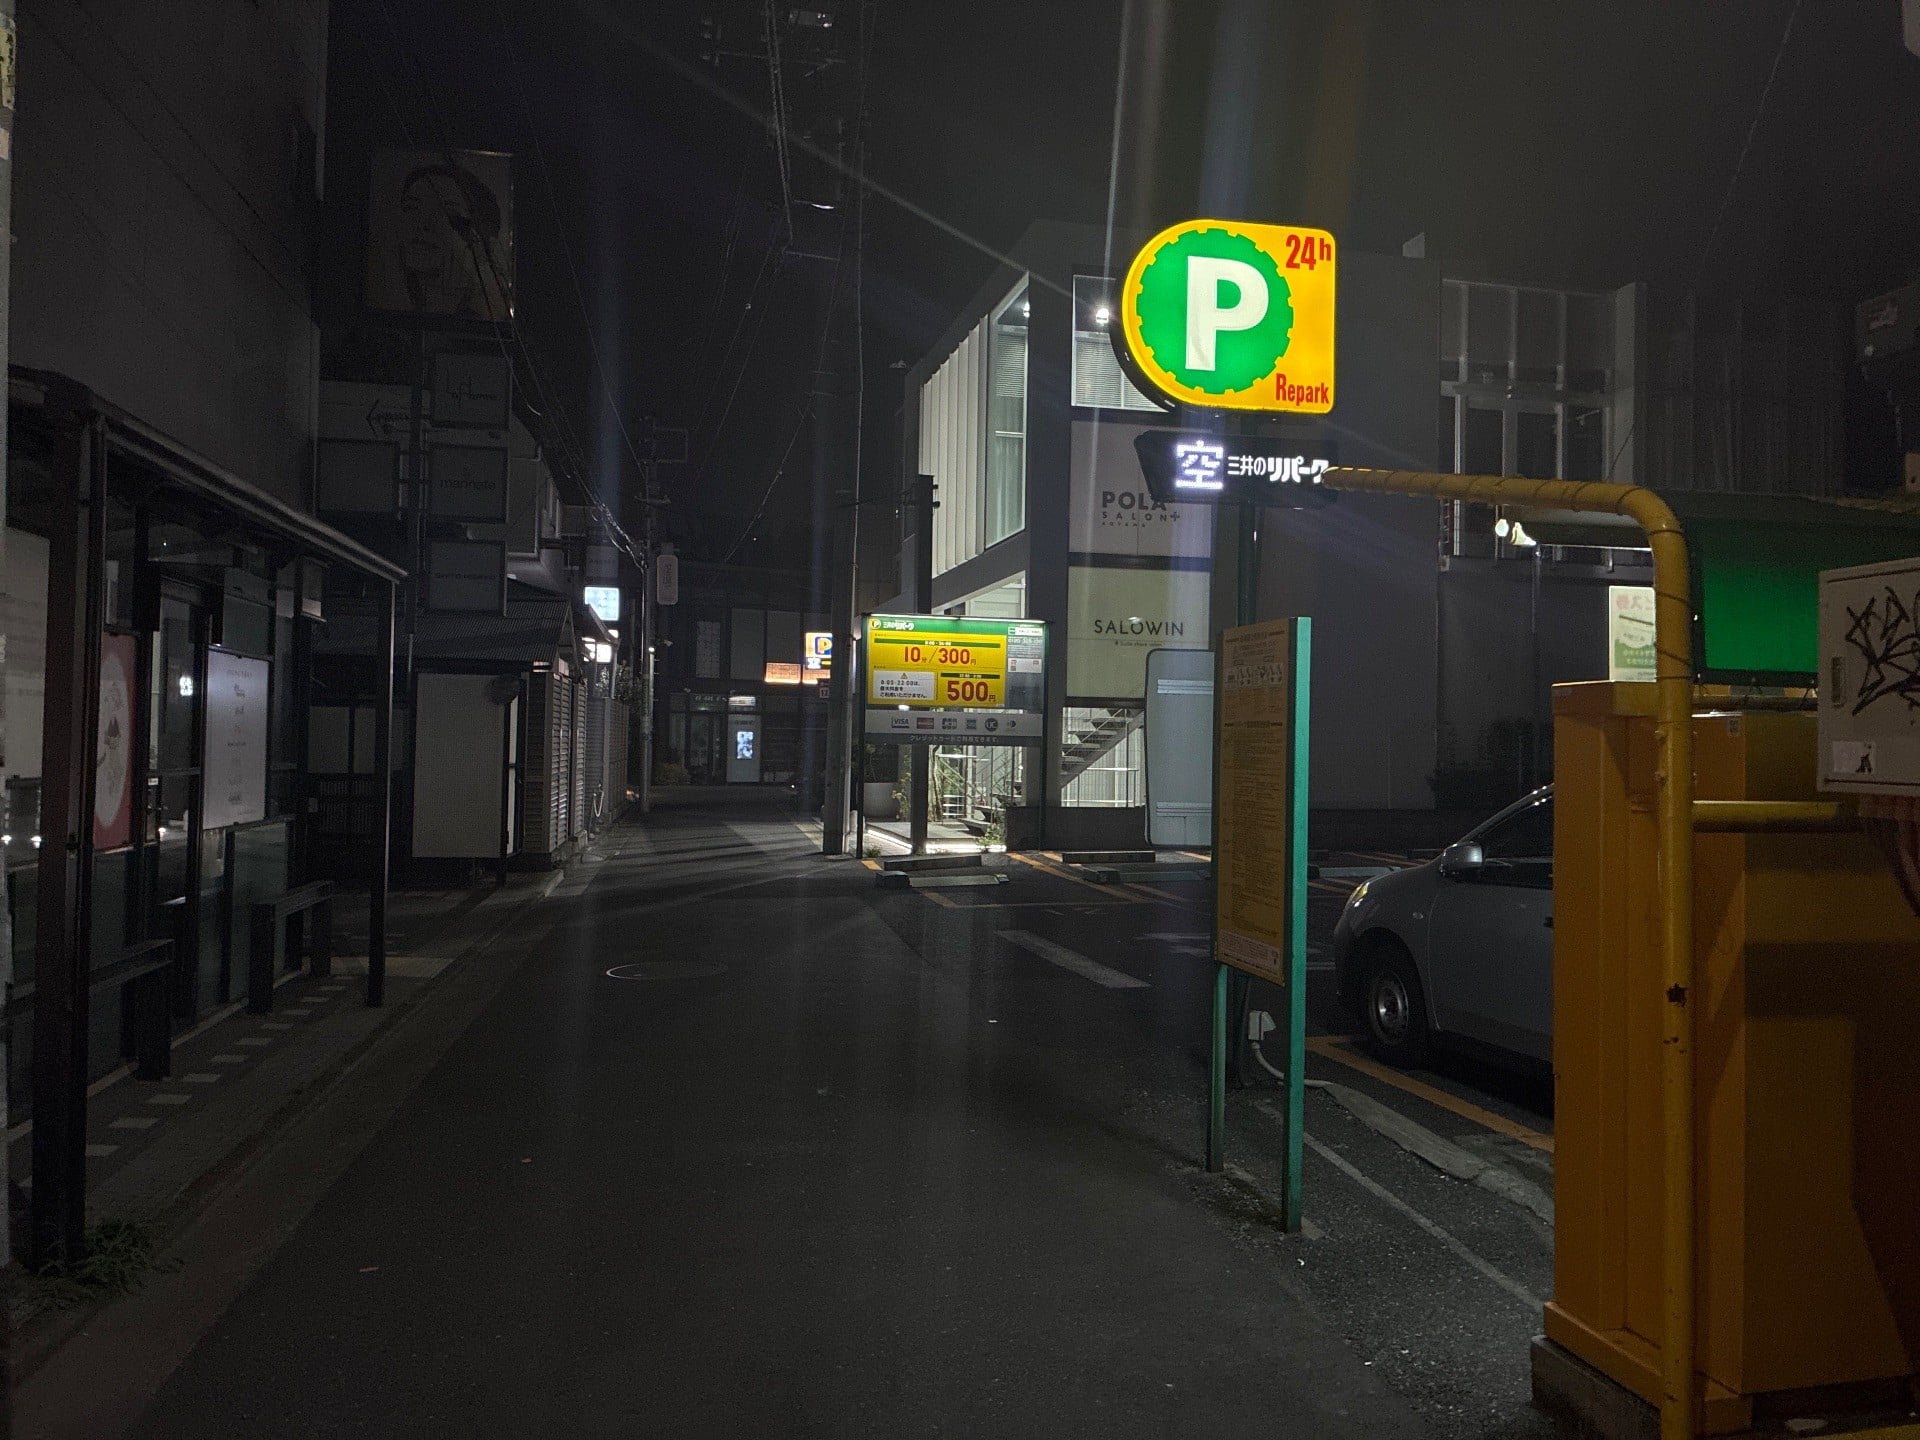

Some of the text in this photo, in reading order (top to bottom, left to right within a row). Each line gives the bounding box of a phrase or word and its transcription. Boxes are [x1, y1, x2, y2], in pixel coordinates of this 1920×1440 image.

[1286, 234, 1332, 270] 24h
[1185, 256, 1269, 371] P
[1276, 373, 1329, 406] Repark
[1176, 440, 1223, 489] 空
[1227, 454, 1329, 484] 三井のリパーク
[1102, 491, 1166, 511] POLA
[1094, 619, 1184, 636] SALOWIN
